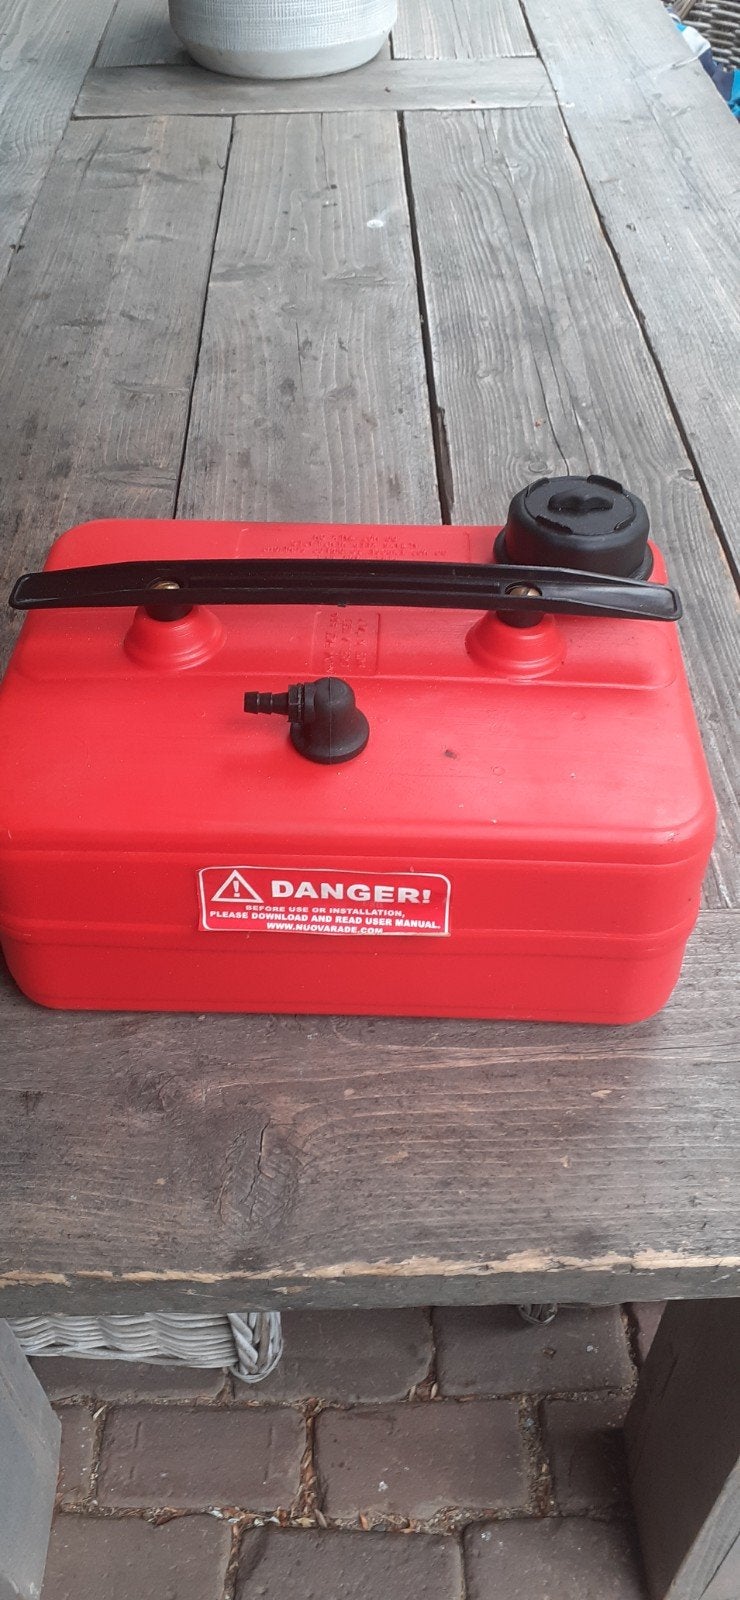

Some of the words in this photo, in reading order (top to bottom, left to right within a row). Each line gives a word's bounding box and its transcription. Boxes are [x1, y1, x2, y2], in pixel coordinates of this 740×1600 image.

[271, 880, 431, 904] DANGER!
[210, 911, 248, 919] PLEASE
[251, 912, 308, 921] DOWNLOAD
[335, 915, 363, 924] READ
[365, 917, 392, 926] USER
[395, 919, 441, 929] MANUAL.
[329, 908, 405, 918] INSTALLATION,
[266, 922, 384, 935] WWW.NUOVARADE.COM
